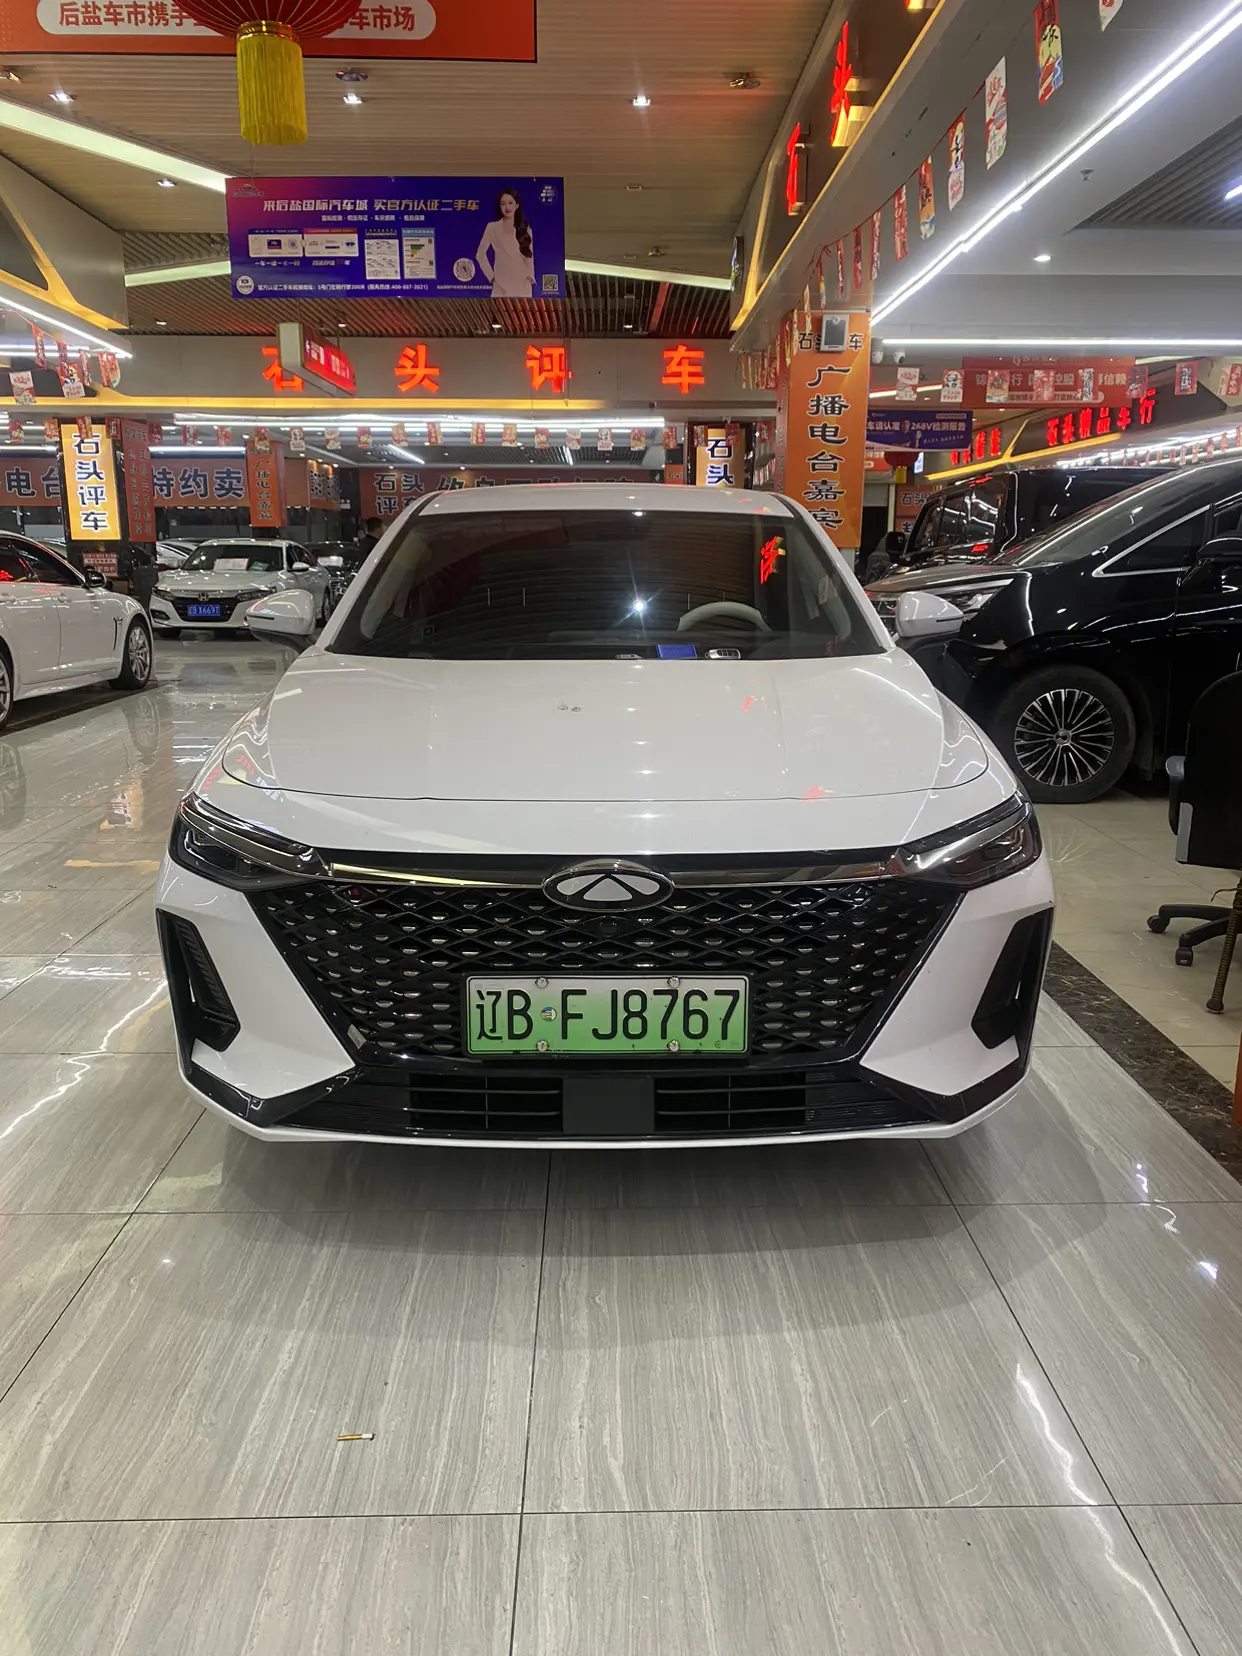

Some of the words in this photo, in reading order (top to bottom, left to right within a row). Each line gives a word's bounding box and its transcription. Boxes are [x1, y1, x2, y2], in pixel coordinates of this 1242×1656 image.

[59, 0, 204, 27] 后盐车市携手
[346, 4, 415, 31] 车市场
[373, 199, 480, 211] 买官方认证二手车
[798, 332, 865, 351] 石车
[706, 437, 735, 486] 石头
[803, 365, 851, 529] 广播电台嘉宾
[72, 432, 109, 532] 石头评车
[373, 472, 425, 493] 石头
